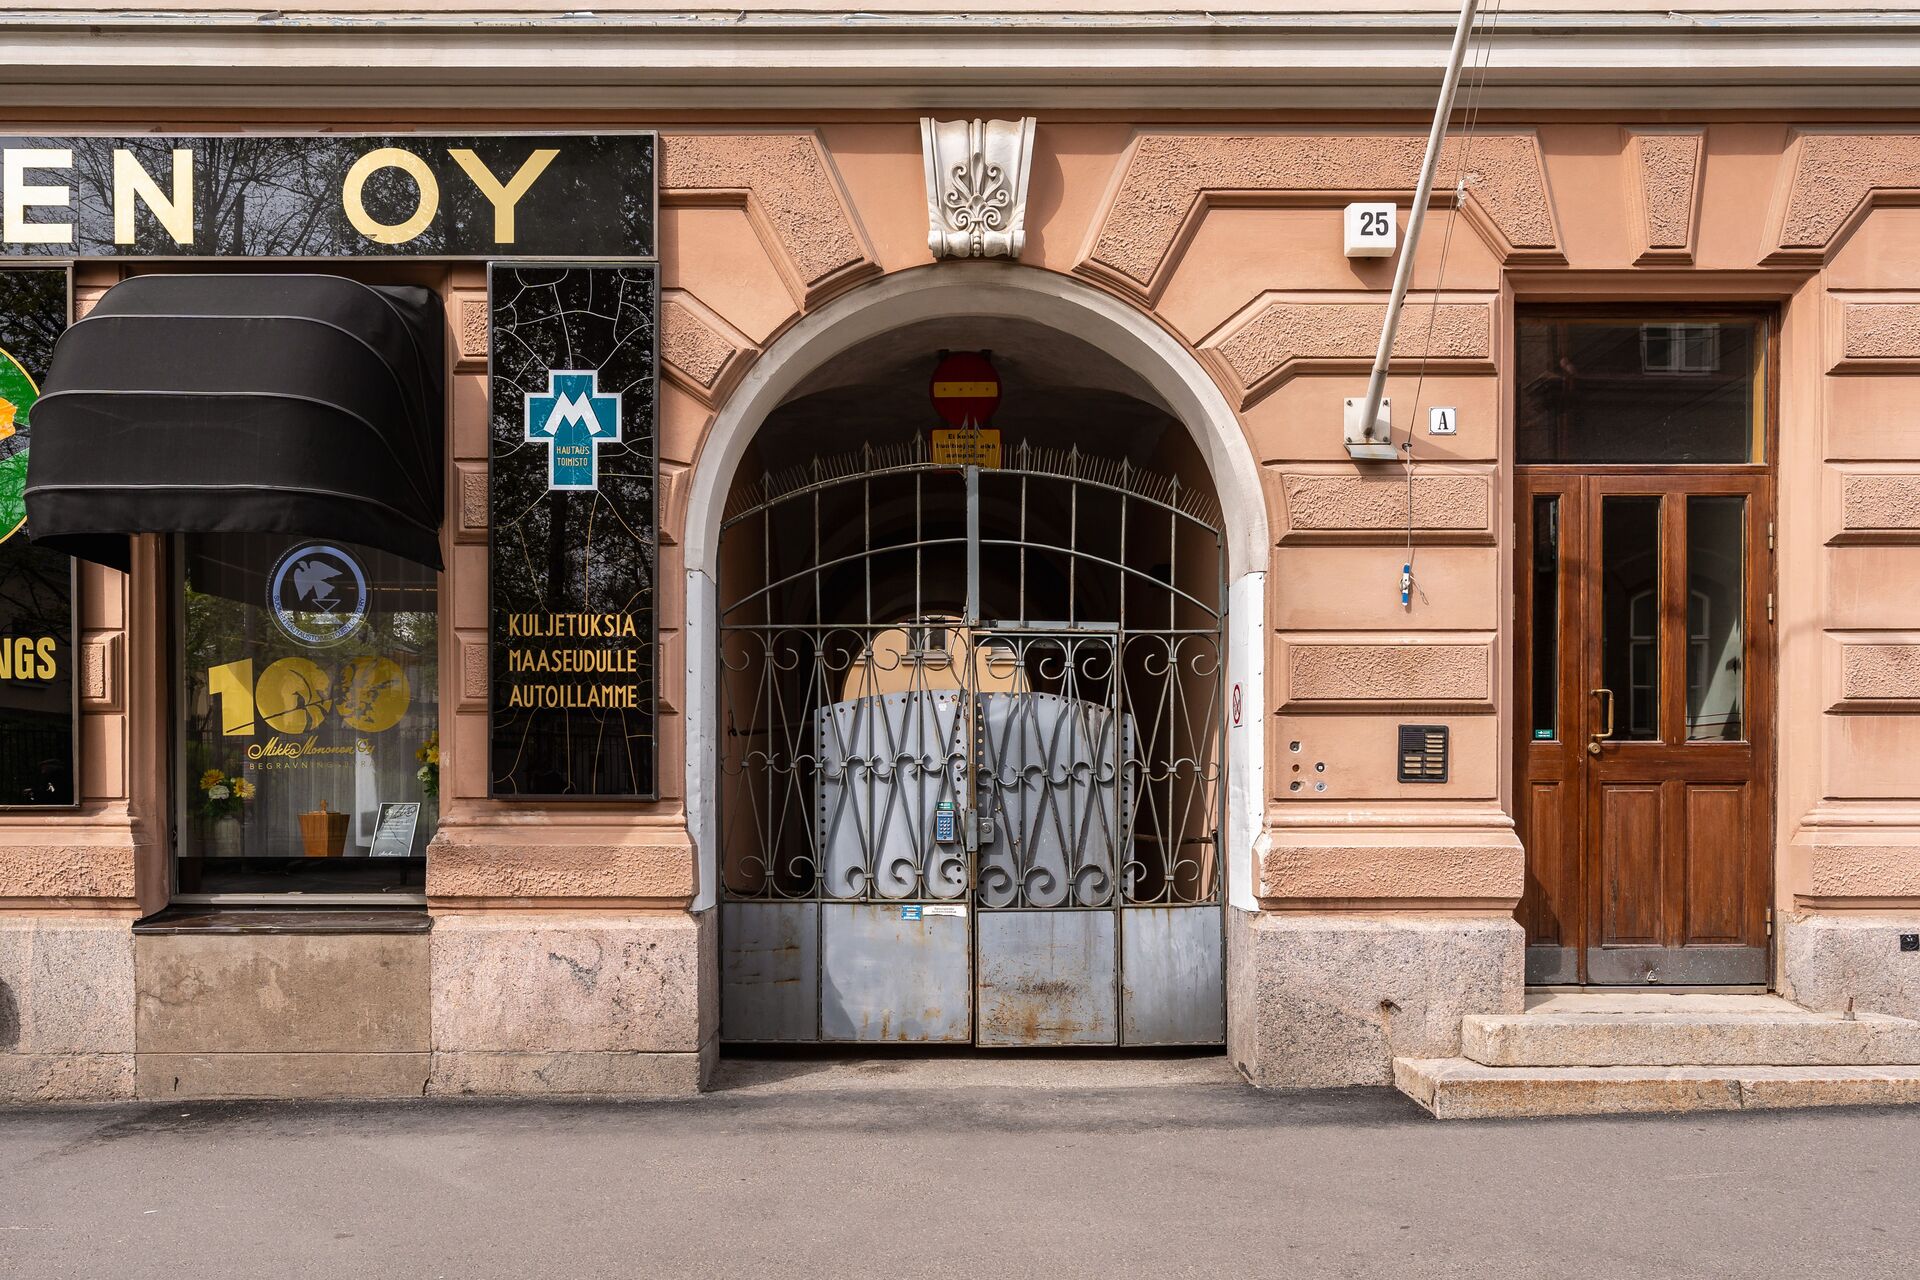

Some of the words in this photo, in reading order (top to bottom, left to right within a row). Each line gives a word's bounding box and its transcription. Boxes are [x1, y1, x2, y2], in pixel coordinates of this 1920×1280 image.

[343, 147, 561, 244] OY
[1360, 211, 1389, 236] 25
[543, 391, 602, 436] M
[1438, 411, 1449, 431] A
[556, 446, 590, 454] HAUTAUS
[557, 458, 588, 466] TOIMISTO
[509, 614, 637, 637] KULJETUKSIA
[509, 650, 637, 672] MAASEUDULLE
[509, 685, 637, 707] AUTOILLAMME
[248, 736, 300, 760] Mikko
